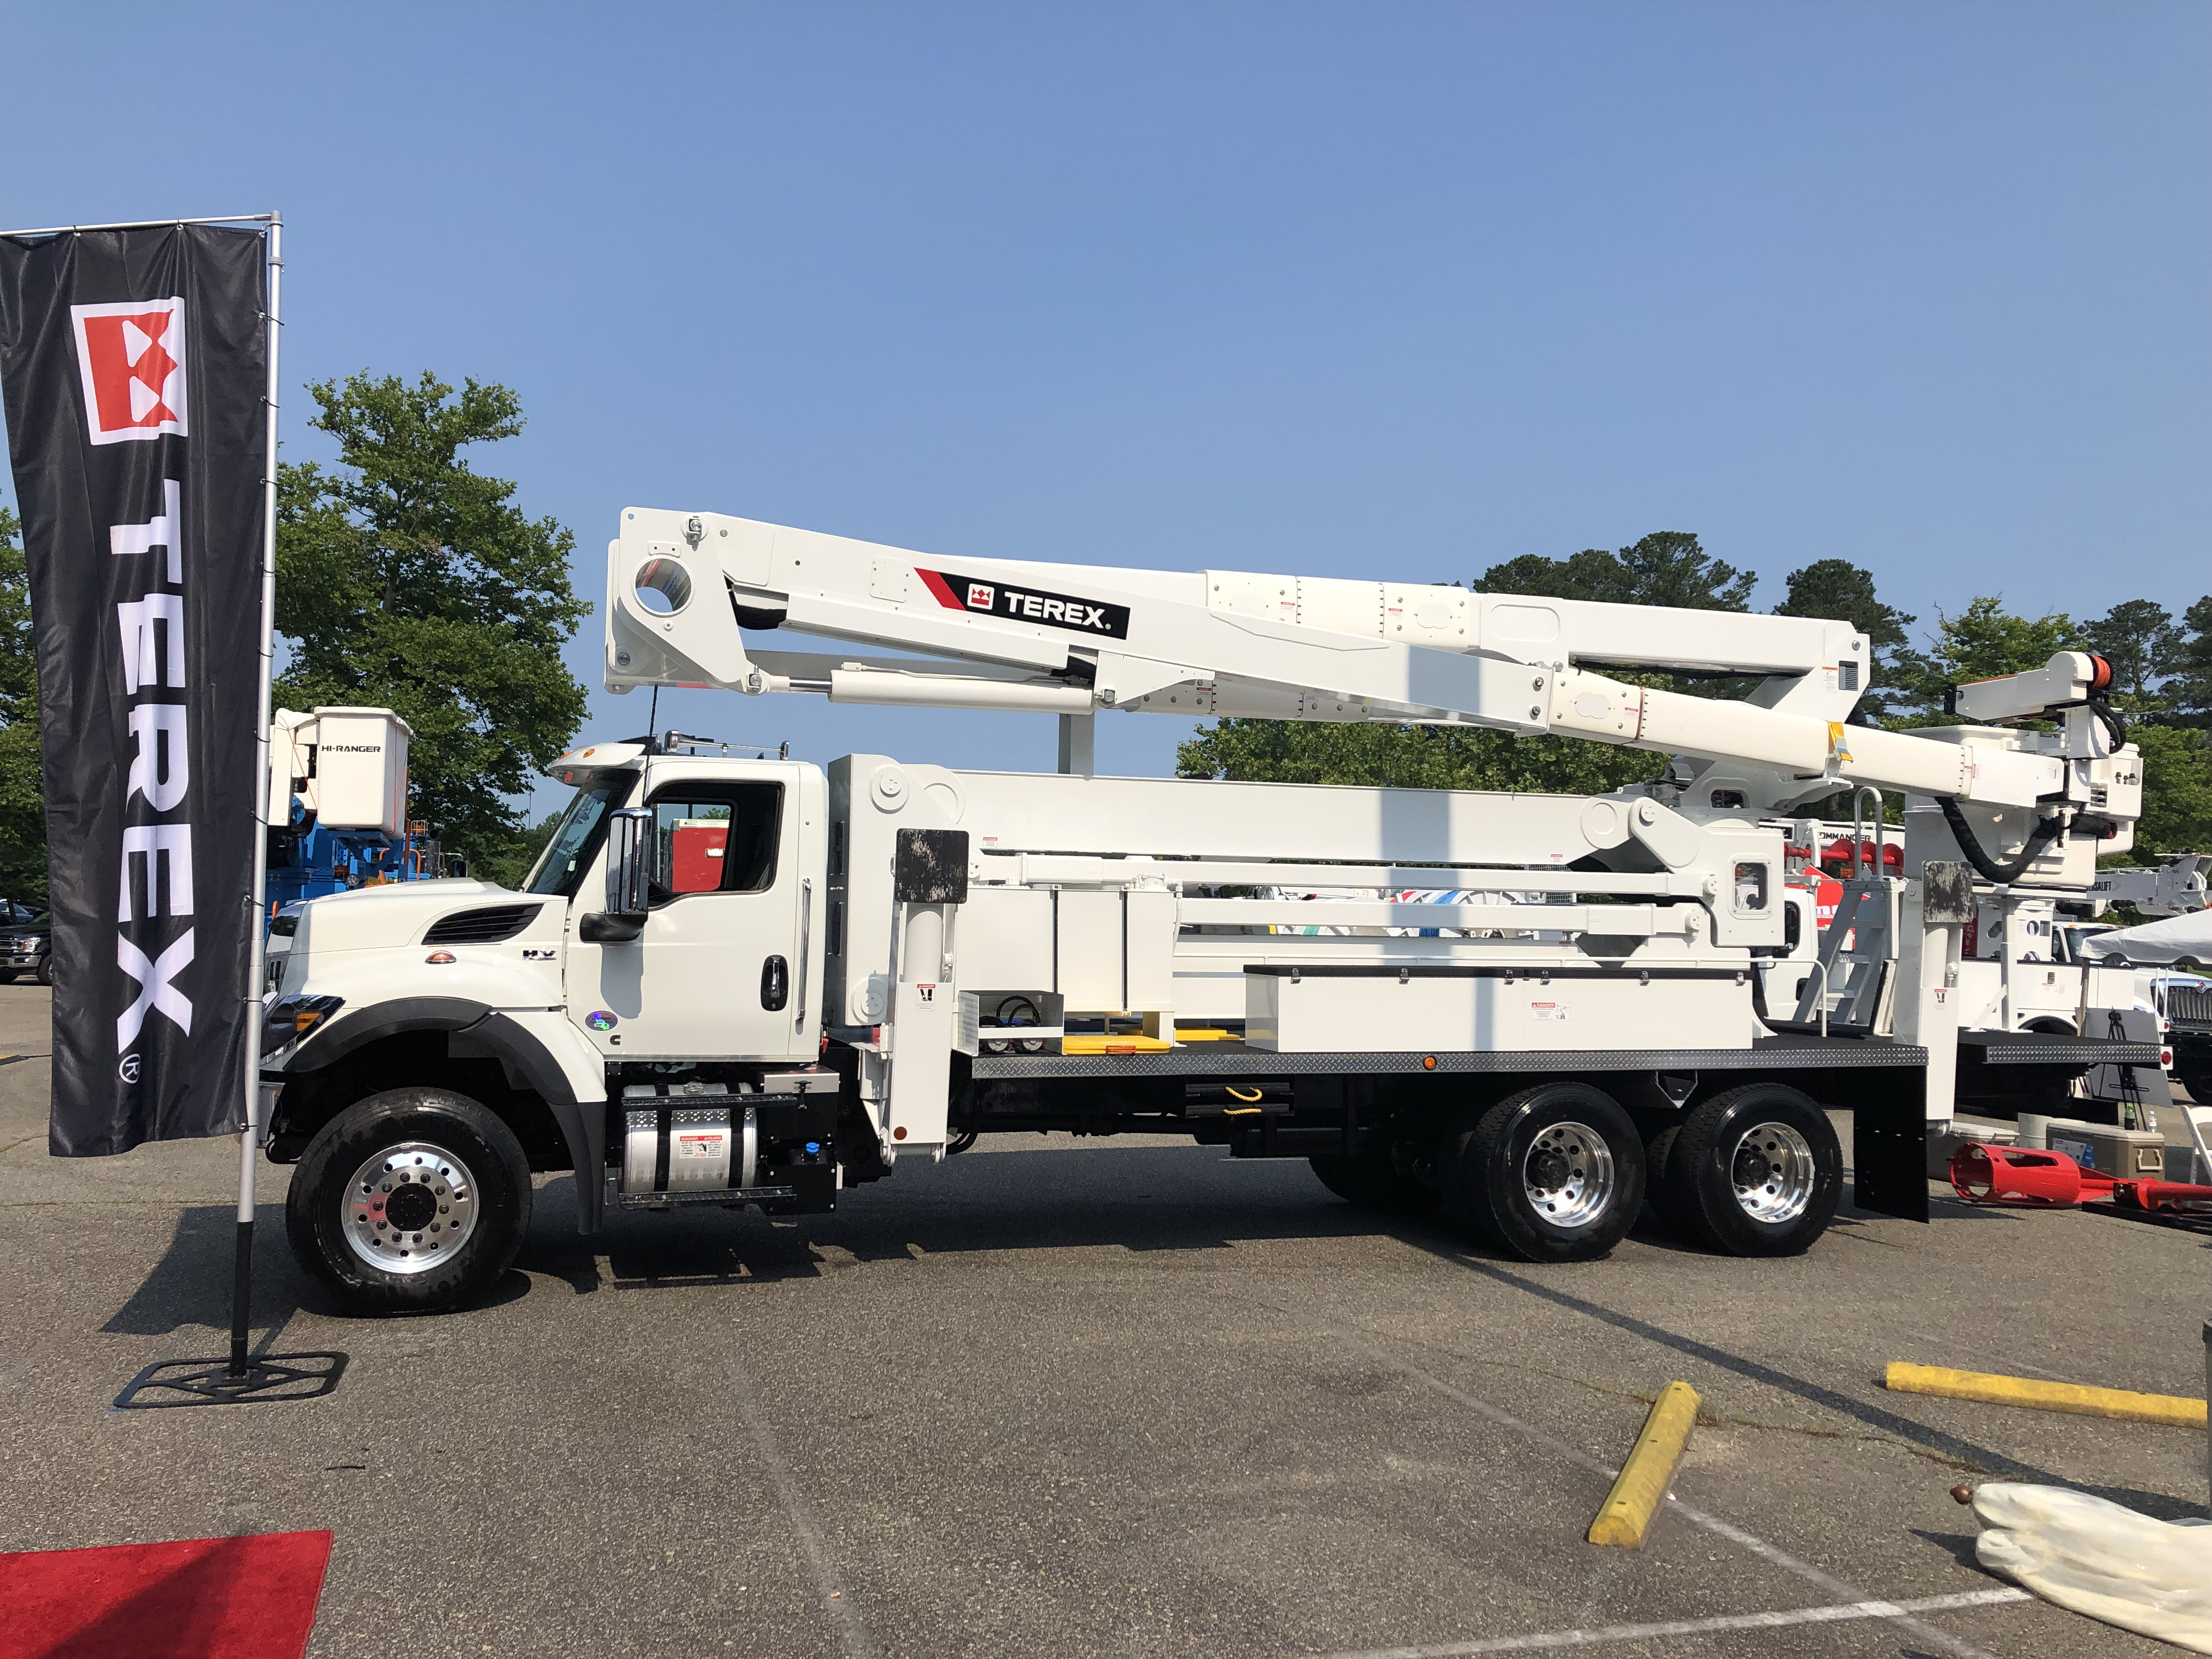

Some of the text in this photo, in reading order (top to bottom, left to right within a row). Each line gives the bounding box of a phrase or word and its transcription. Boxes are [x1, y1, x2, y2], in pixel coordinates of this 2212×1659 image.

[1005, 591, 1105, 629] TEREX
[110, 478, 195, 1055] TEREX
[1818, 831, 1871, 842] OMMANDER
[523, 950, 557, 958] HV
